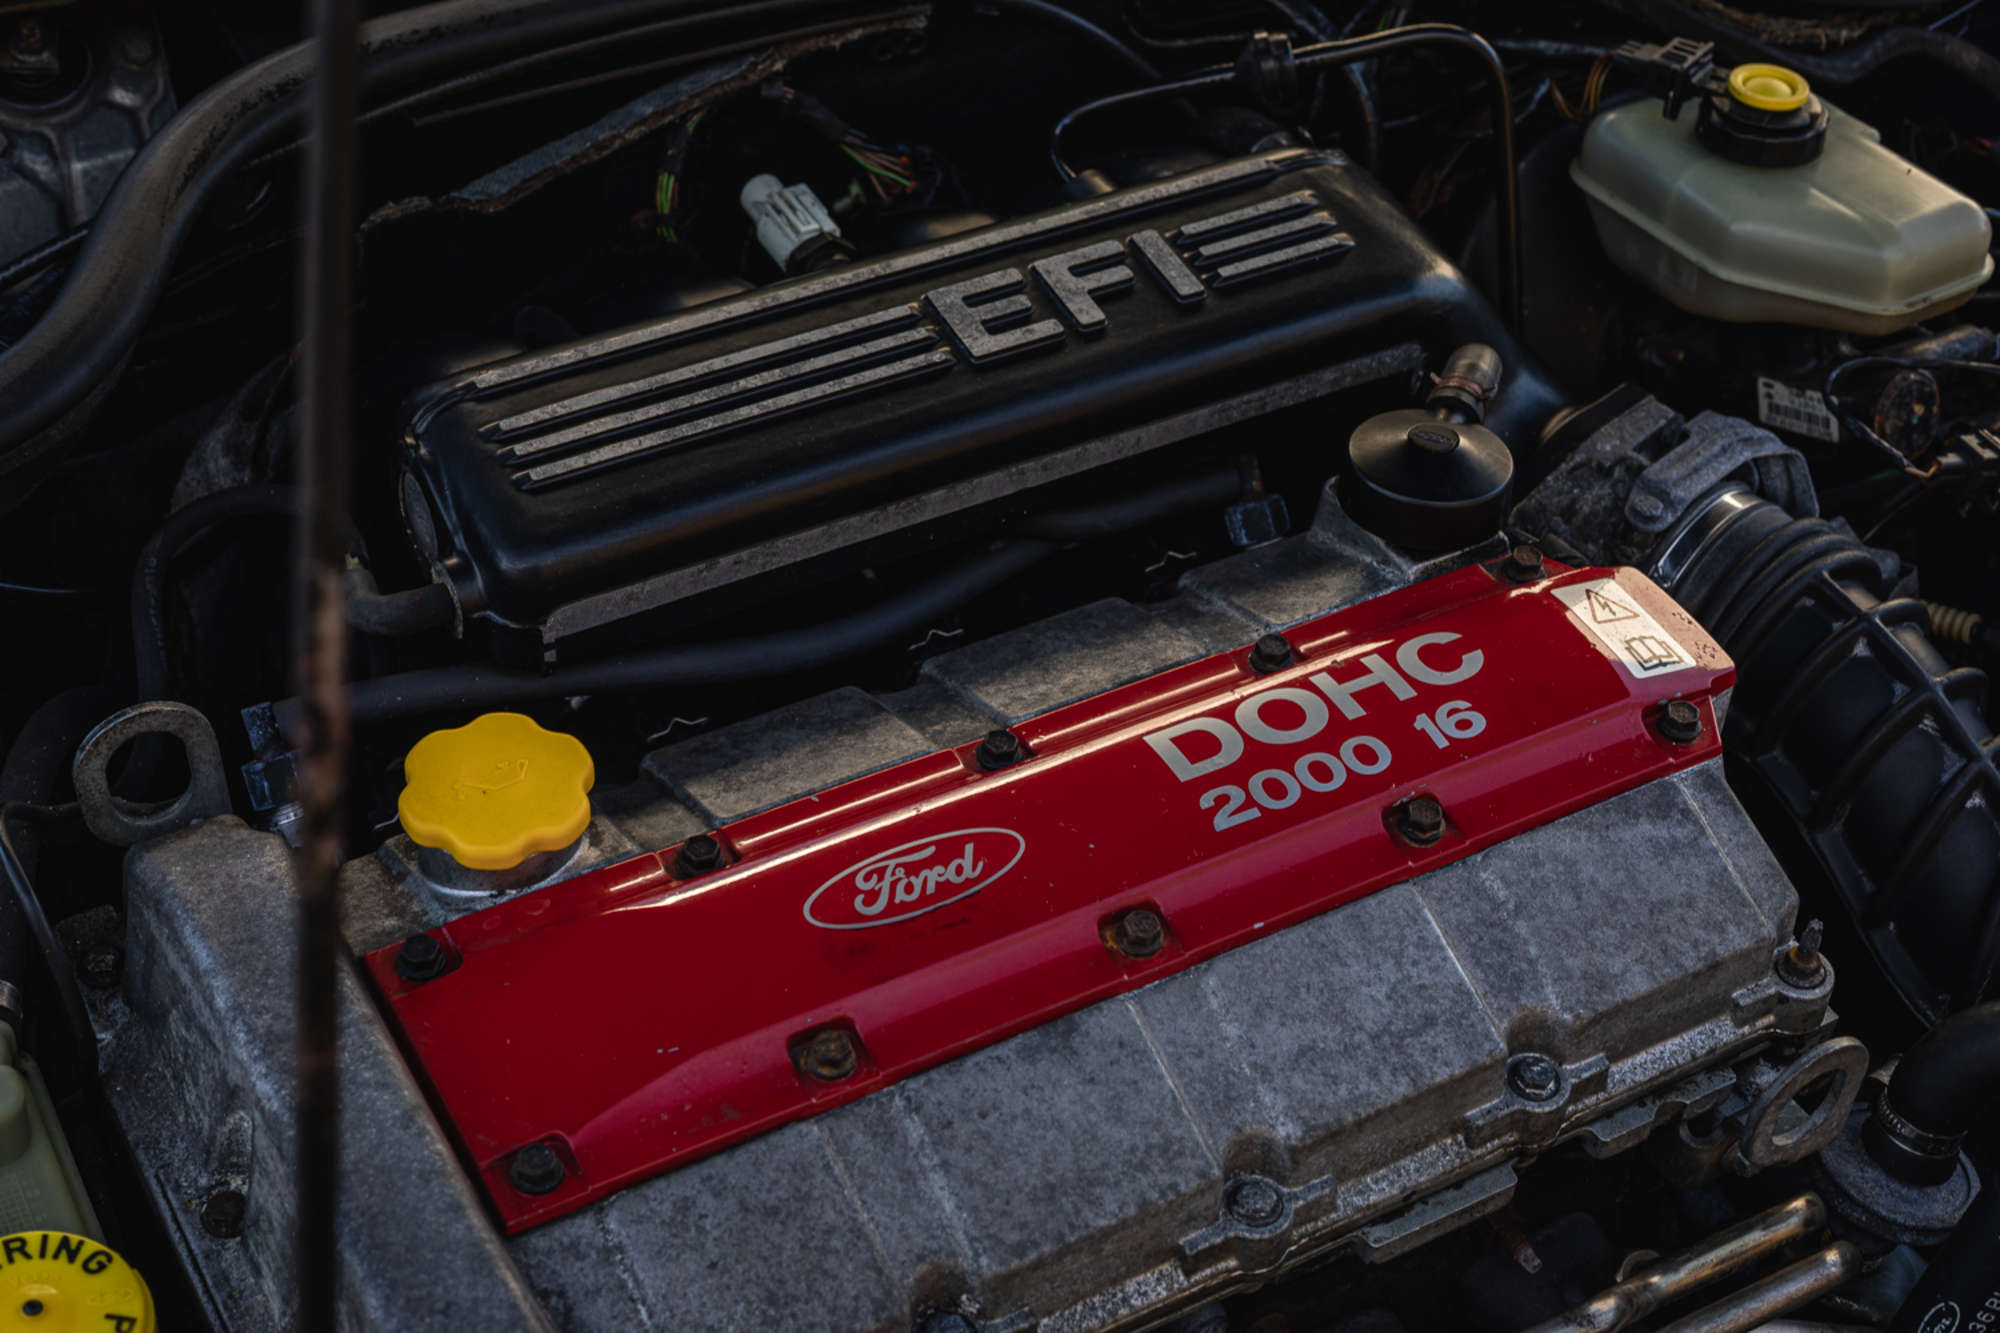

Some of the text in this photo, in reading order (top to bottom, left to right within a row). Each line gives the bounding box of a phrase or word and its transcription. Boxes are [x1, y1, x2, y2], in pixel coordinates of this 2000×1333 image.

[922, 229, 1207, 365] EFI
[1142, 631, 1485, 783] DOHC
[1198, 700, 1487, 832] 2000 16
[853, 841, 984, 917] Ford
[0, 1234, 113, 1275] RING
